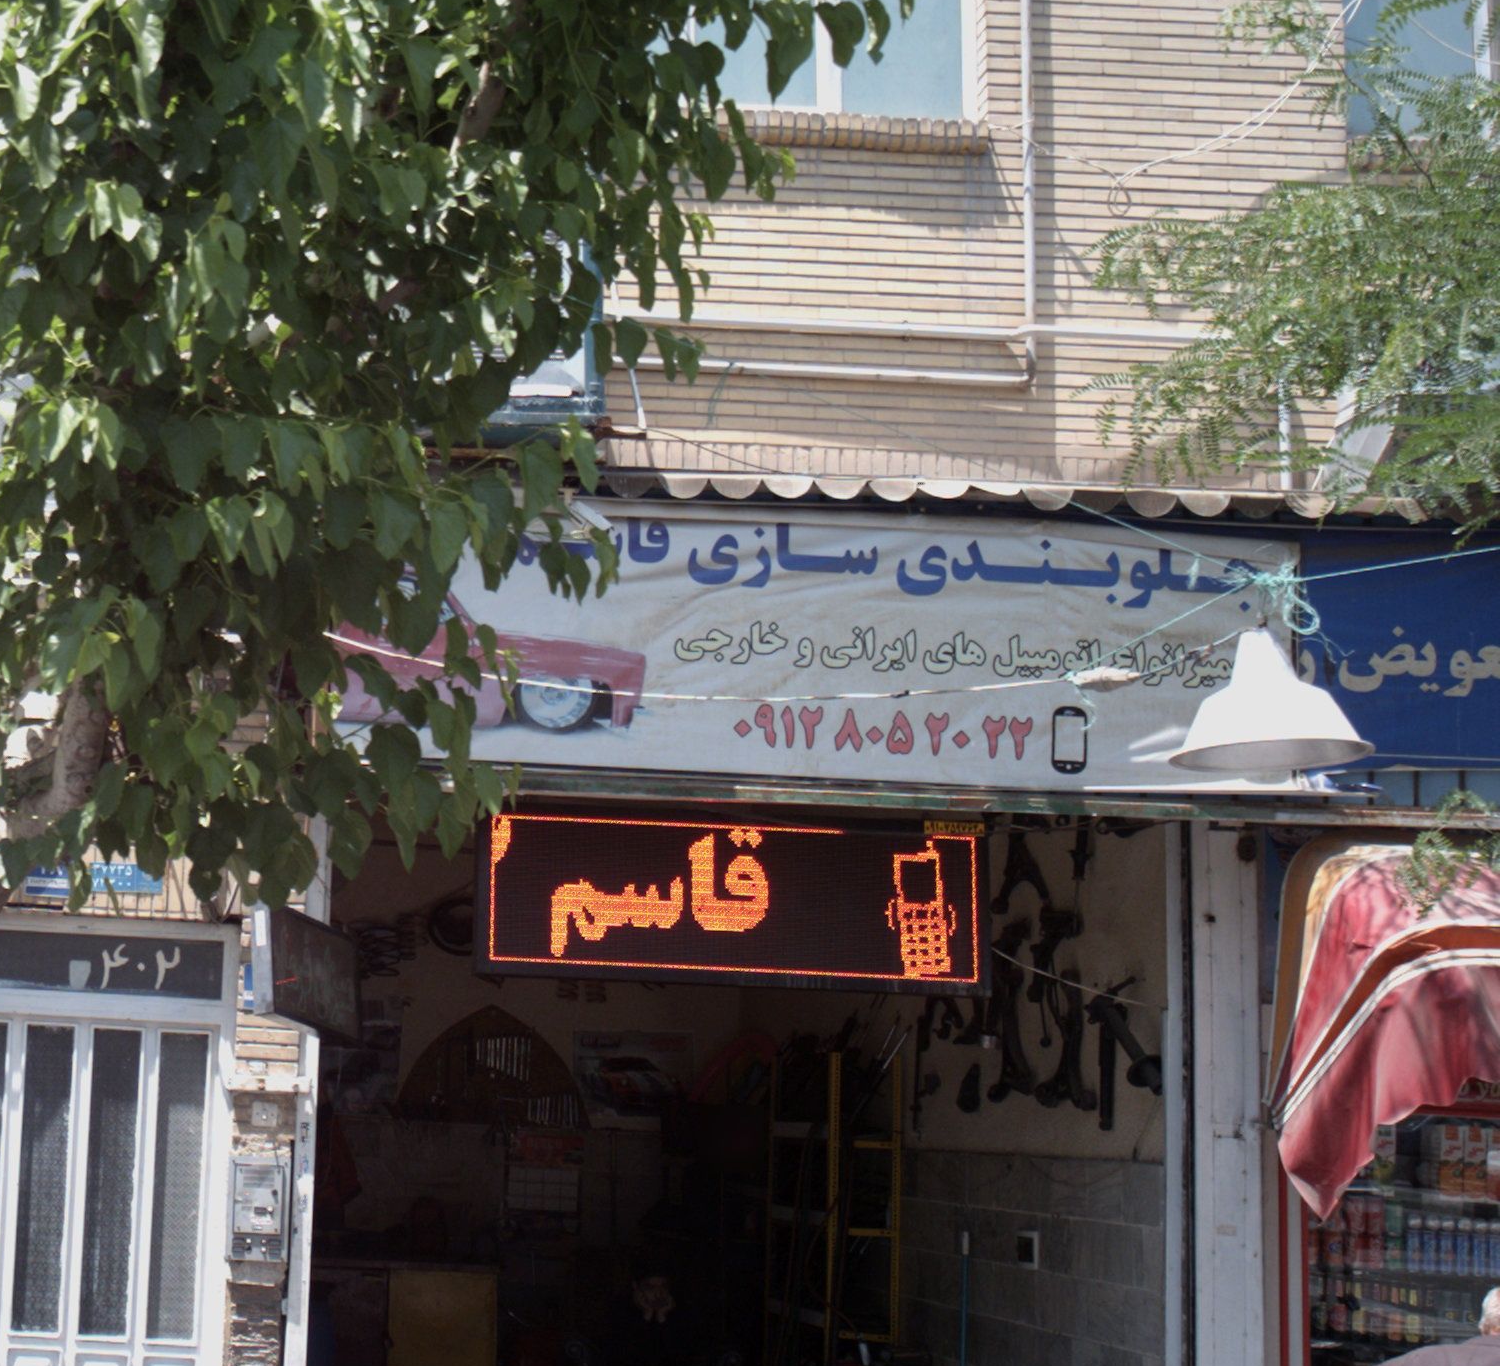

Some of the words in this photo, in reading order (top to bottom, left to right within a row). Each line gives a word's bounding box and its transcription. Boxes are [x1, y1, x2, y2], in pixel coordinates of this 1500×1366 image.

[687, 521, 879, 588] سازی
[674, 620, 788, 663] خارجی
[794, 637, 814, 668] و
[820, 626, 917, 673] ایرانی
[923, 631, 987, 675] های
[1338, 625, 1500, 698] عویض
[733, 703, 824, 750] ۰۹۱۲
[550, 827, 770, 958] قاسم
